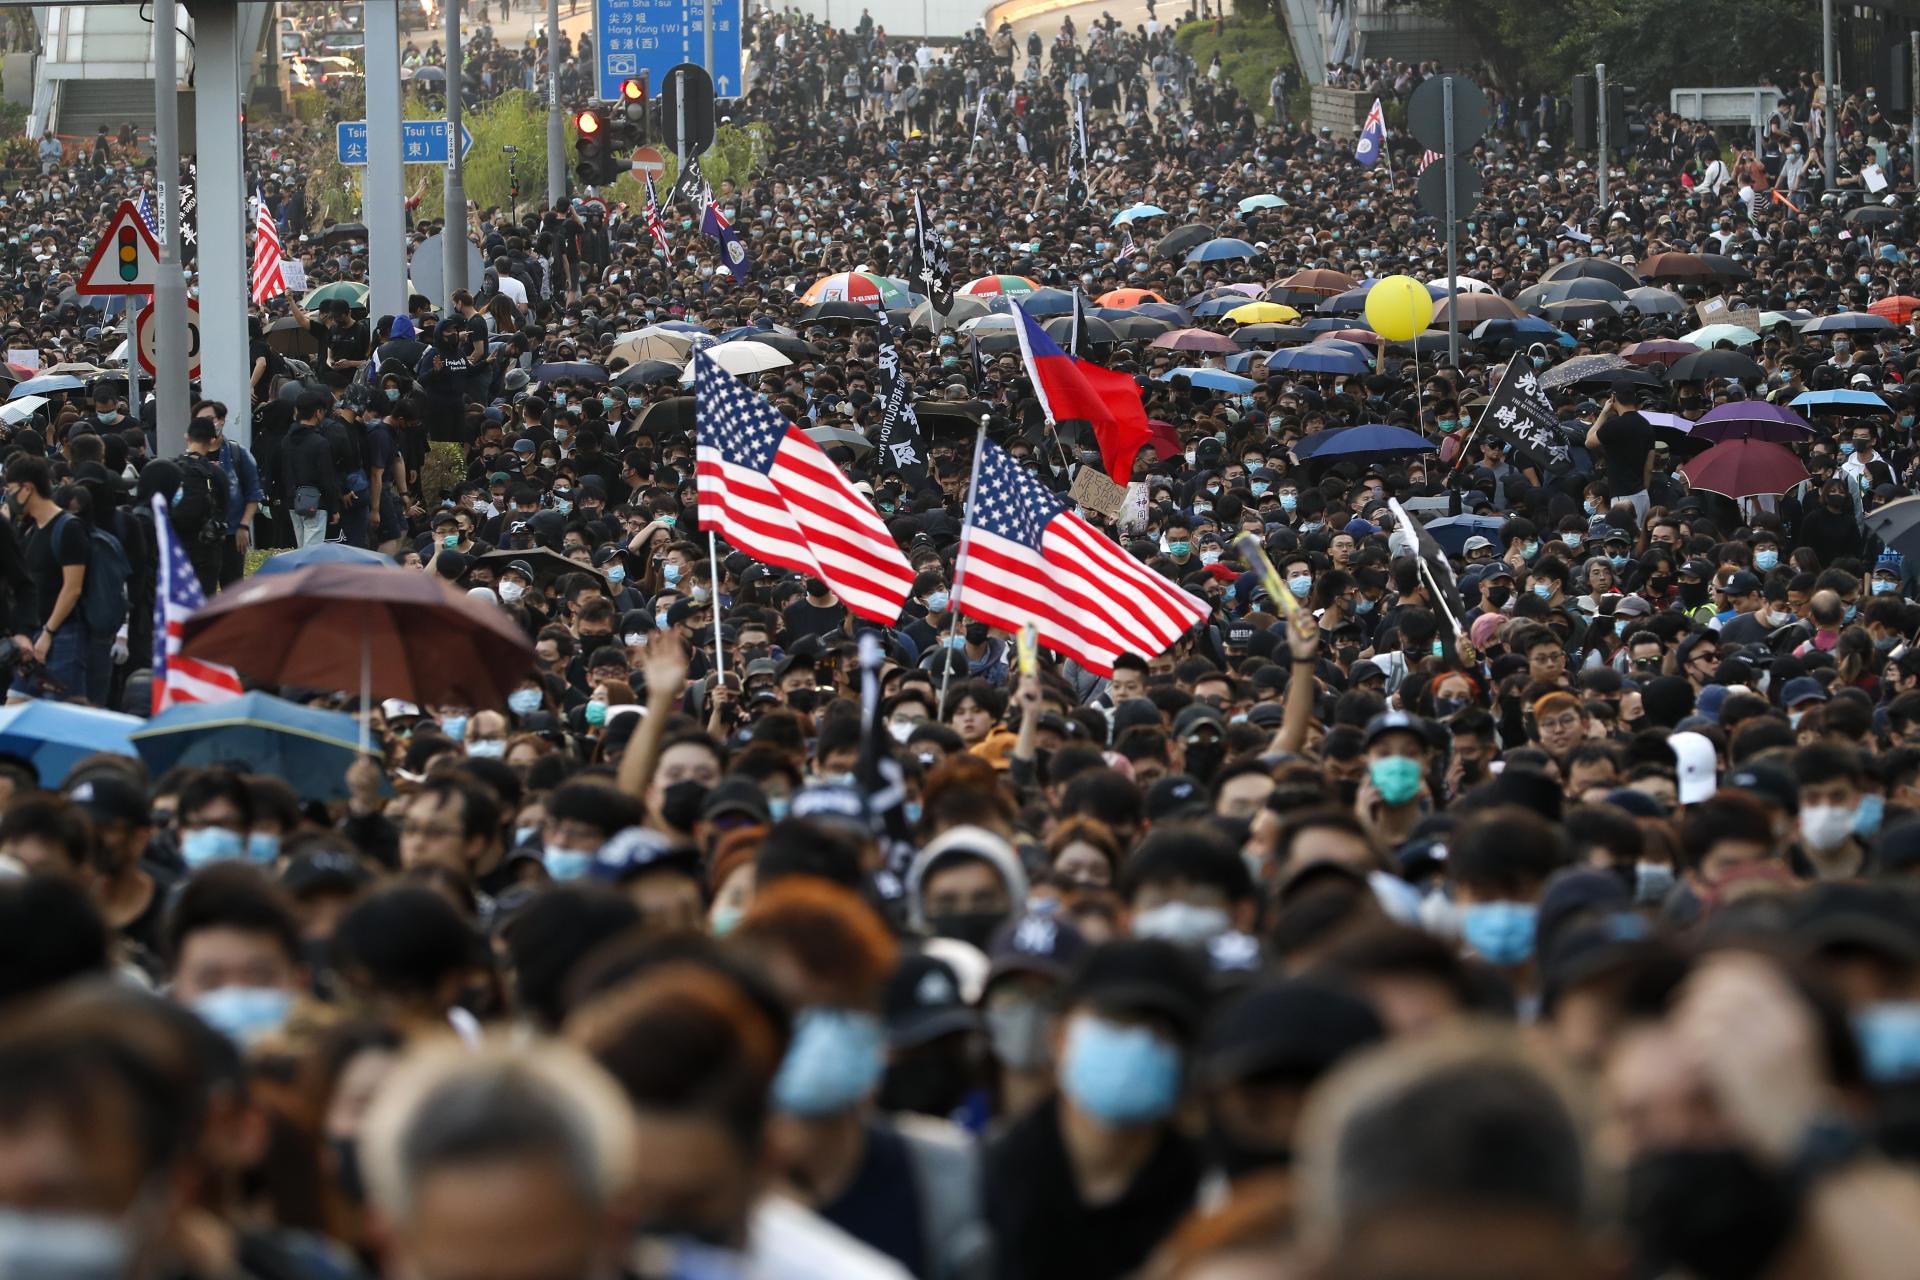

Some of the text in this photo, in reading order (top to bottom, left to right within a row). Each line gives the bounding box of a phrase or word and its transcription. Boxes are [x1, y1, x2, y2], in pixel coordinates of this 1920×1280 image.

[609, 13, 647, 23] 尖沙咀
[608, 24, 680, 35] Hong Kong (W)
[609, 36, 659, 50] 香港(西)
[405, 126, 425, 136] Tsui
[431, 125, 448, 136] (E)
[851, 294, 879, 303] 7-ELEVEN
[1493, 405, 1572, 465] 時代革命
[1078, 478, 1122, 506] WE STAND
[1080, 491, 1111, 512] AS ONE
